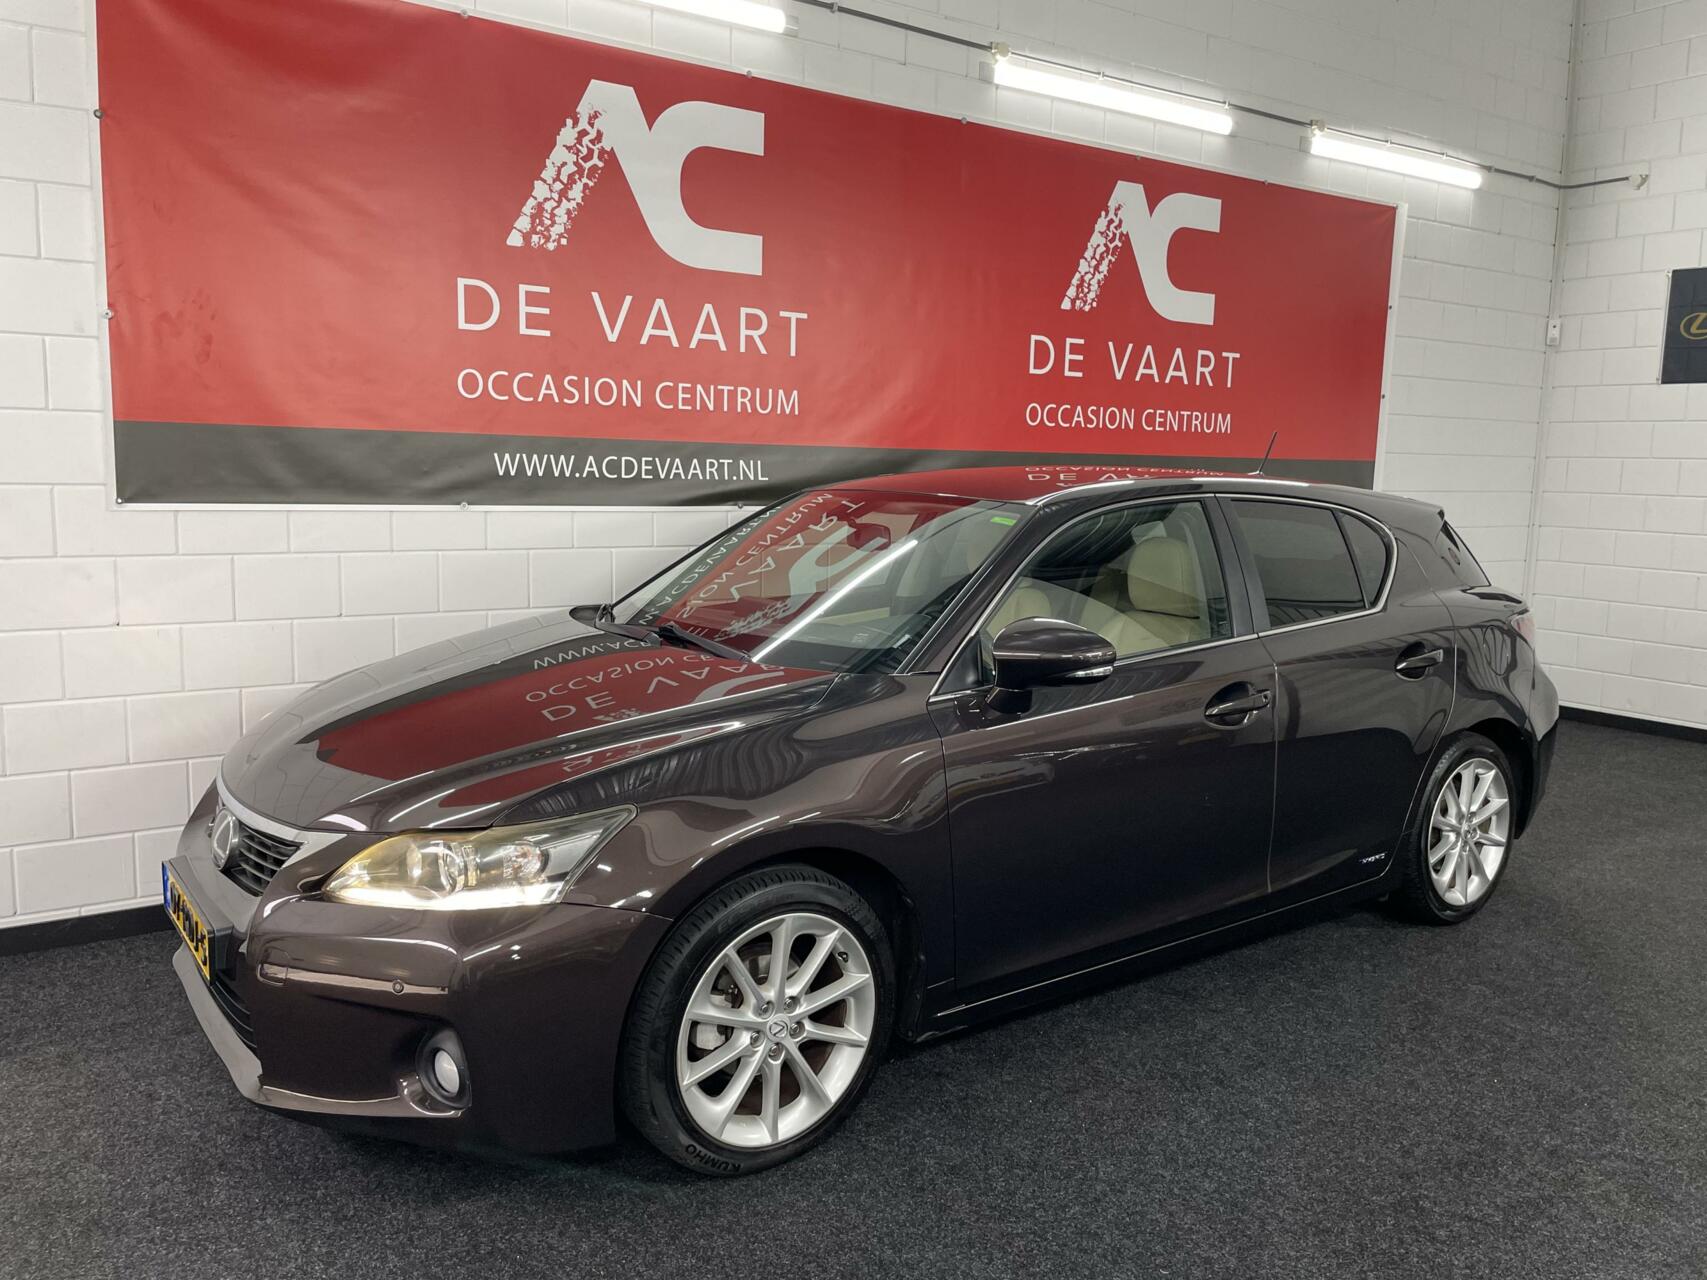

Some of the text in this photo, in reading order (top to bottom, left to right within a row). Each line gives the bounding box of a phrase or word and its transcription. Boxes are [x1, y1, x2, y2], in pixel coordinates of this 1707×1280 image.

[506, 79, 765, 276] AC
[1060, 180, 1222, 326] AC
[457, 277, 808, 357] DE VAART
[1028, 334, 1241, 388] DE VAART
[457, 368, 800, 416] OCCASION CENTRUM
[1026, 403, 1232, 434] OCCASION CENTRUM
[494, 452, 769, 481] WWW.ACDEVAART.NL
[685, 1143, 742, 1173] KUMHO
